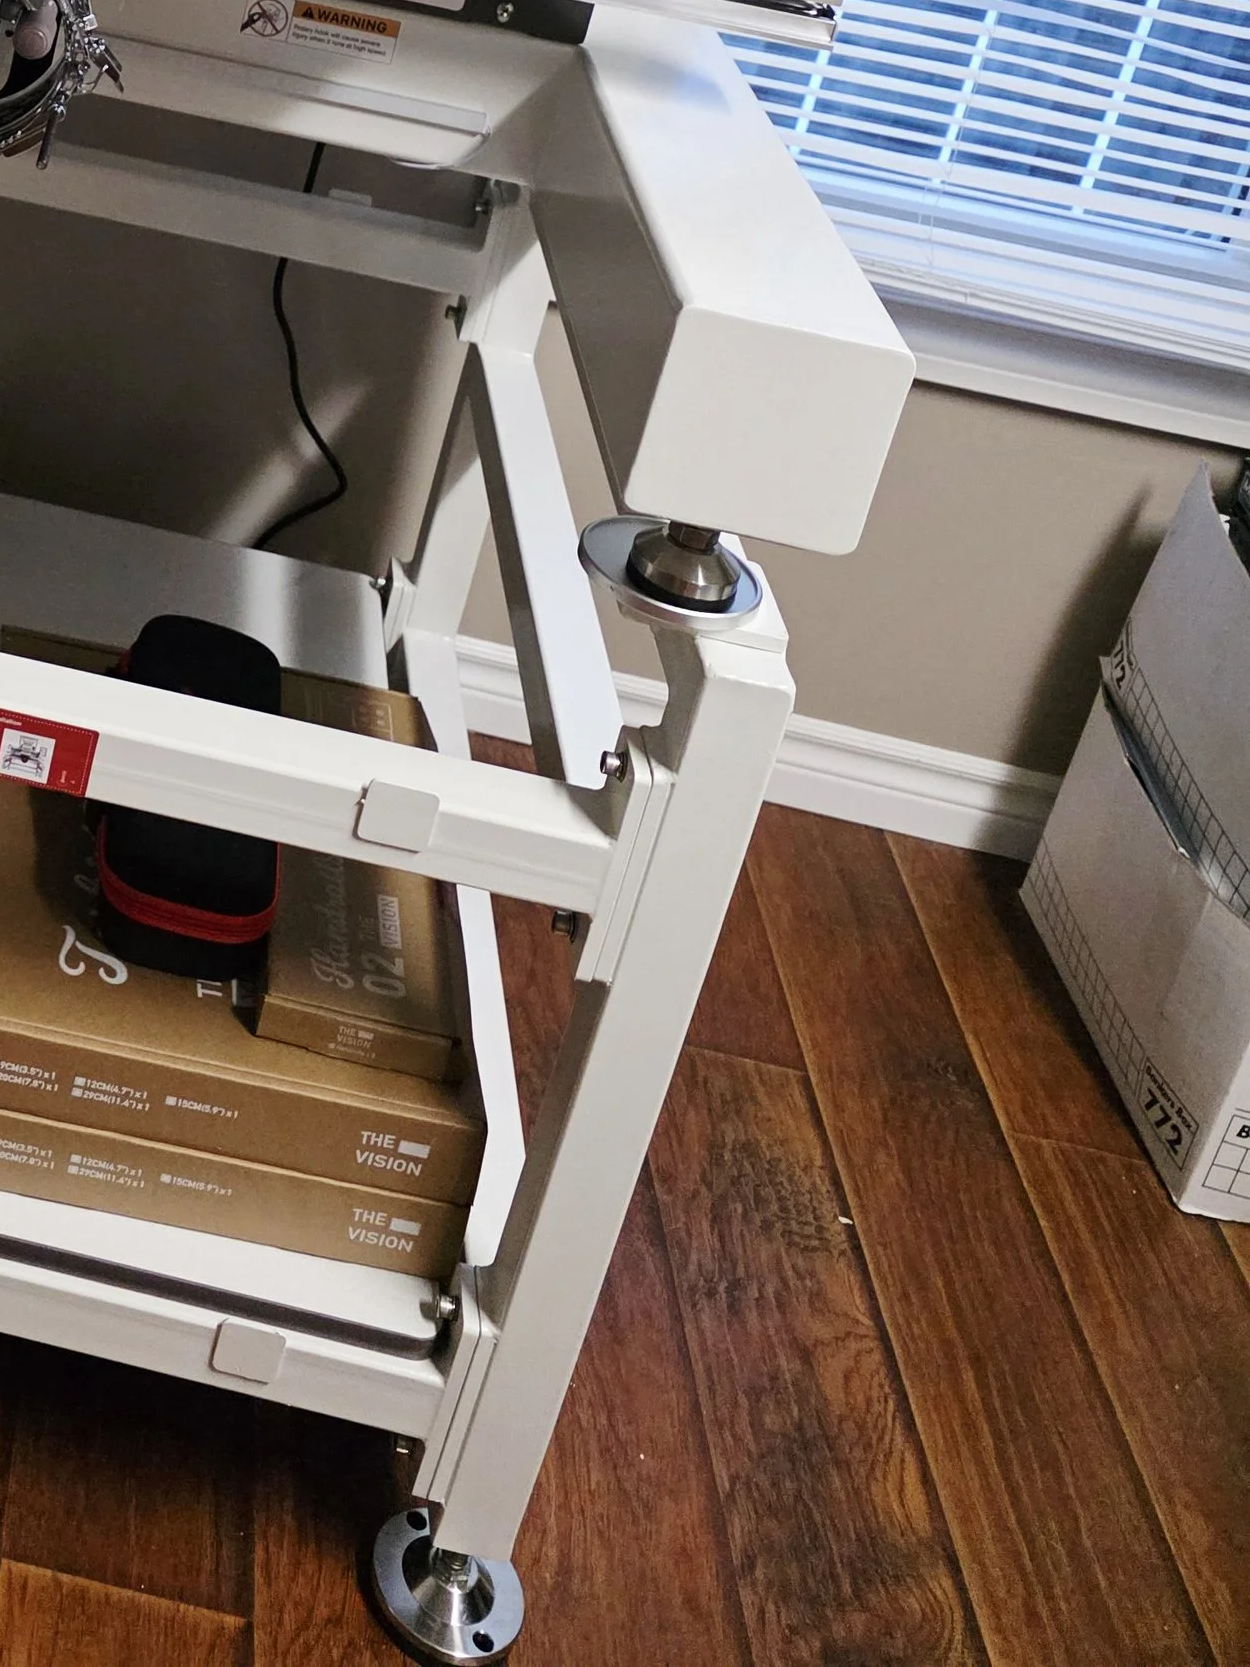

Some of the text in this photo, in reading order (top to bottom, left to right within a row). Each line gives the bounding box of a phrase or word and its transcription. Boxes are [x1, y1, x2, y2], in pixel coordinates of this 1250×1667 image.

[317, 8, 388, 34] WARNING
[381, 897, 399, 948] VISION
[360, 951, 406, 998] 02
[336, 1034, 372, 1049] VISION
[338, 1025, 357, 1037] THE
[1144, 1087, 1182, 1155] 772
[1175, 1106, 1193, 1131] Box
[361, 1131, 396, 1149] THE
[355, 1149, 423, 1177] VISION
[353, 1208, 388, 1226] THE
[348, 1226, 414, 1253] VISION
